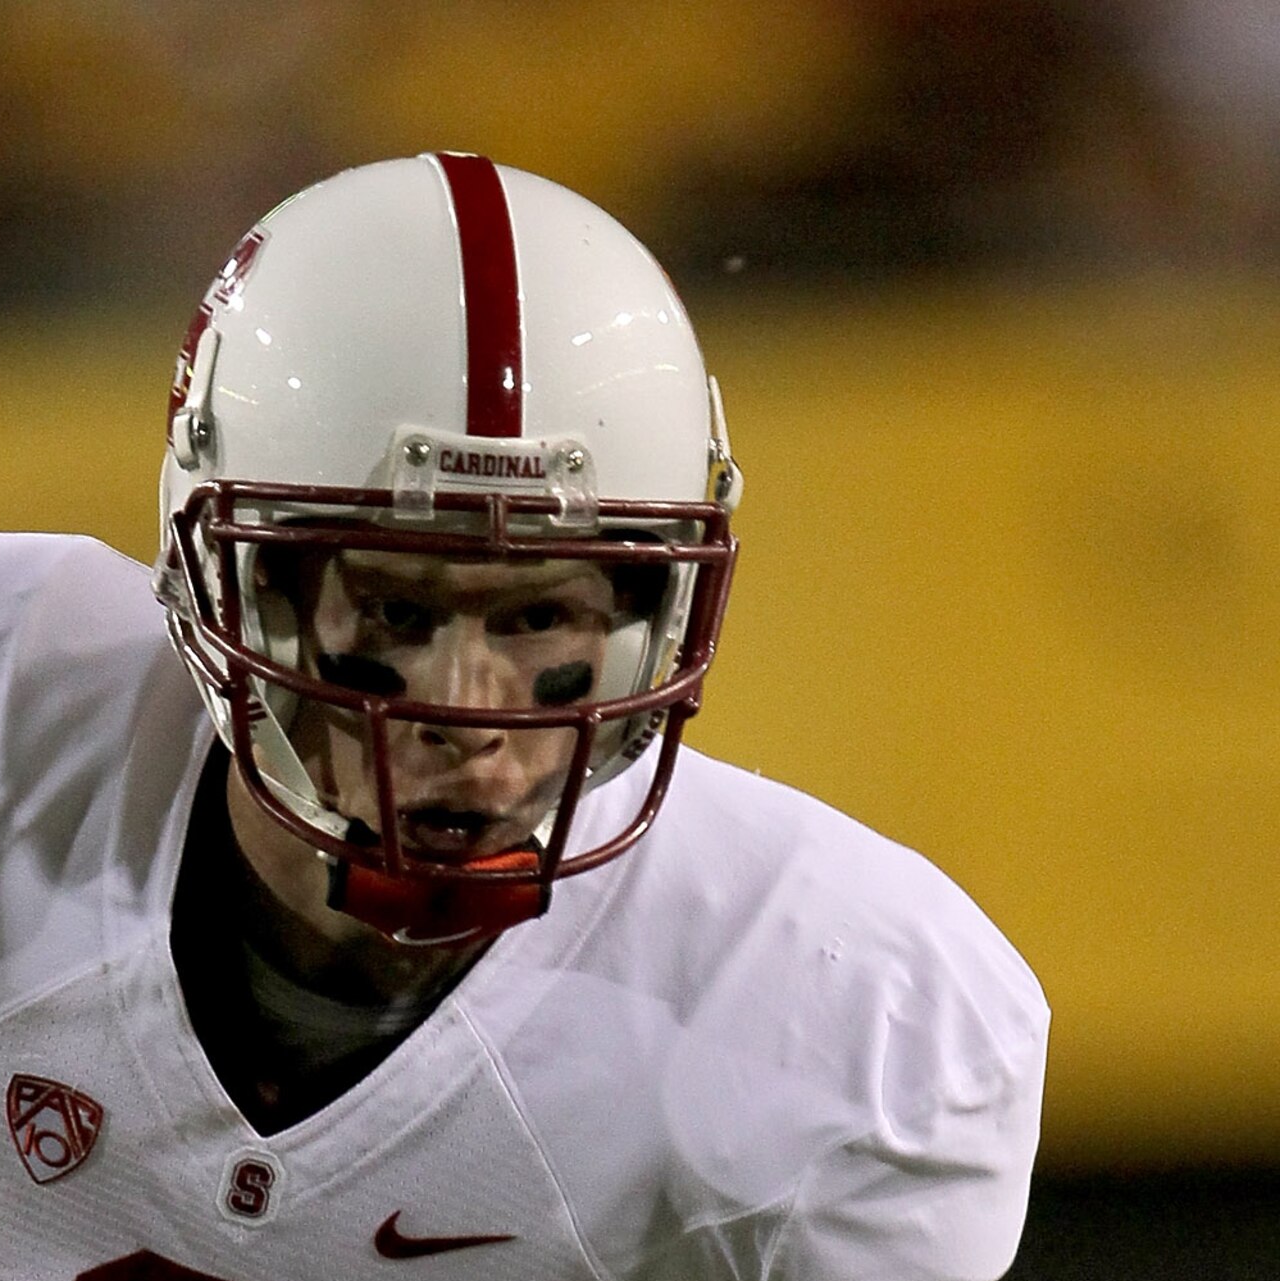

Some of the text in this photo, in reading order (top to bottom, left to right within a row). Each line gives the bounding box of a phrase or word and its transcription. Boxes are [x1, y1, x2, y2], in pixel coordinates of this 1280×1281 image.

[439, 450, 546, 479] CARDINAL
[11, 1078, 101, 1160] PAC
[24, 1121, 72, 1169] 10
[226, 1158, 276, 1218] S
